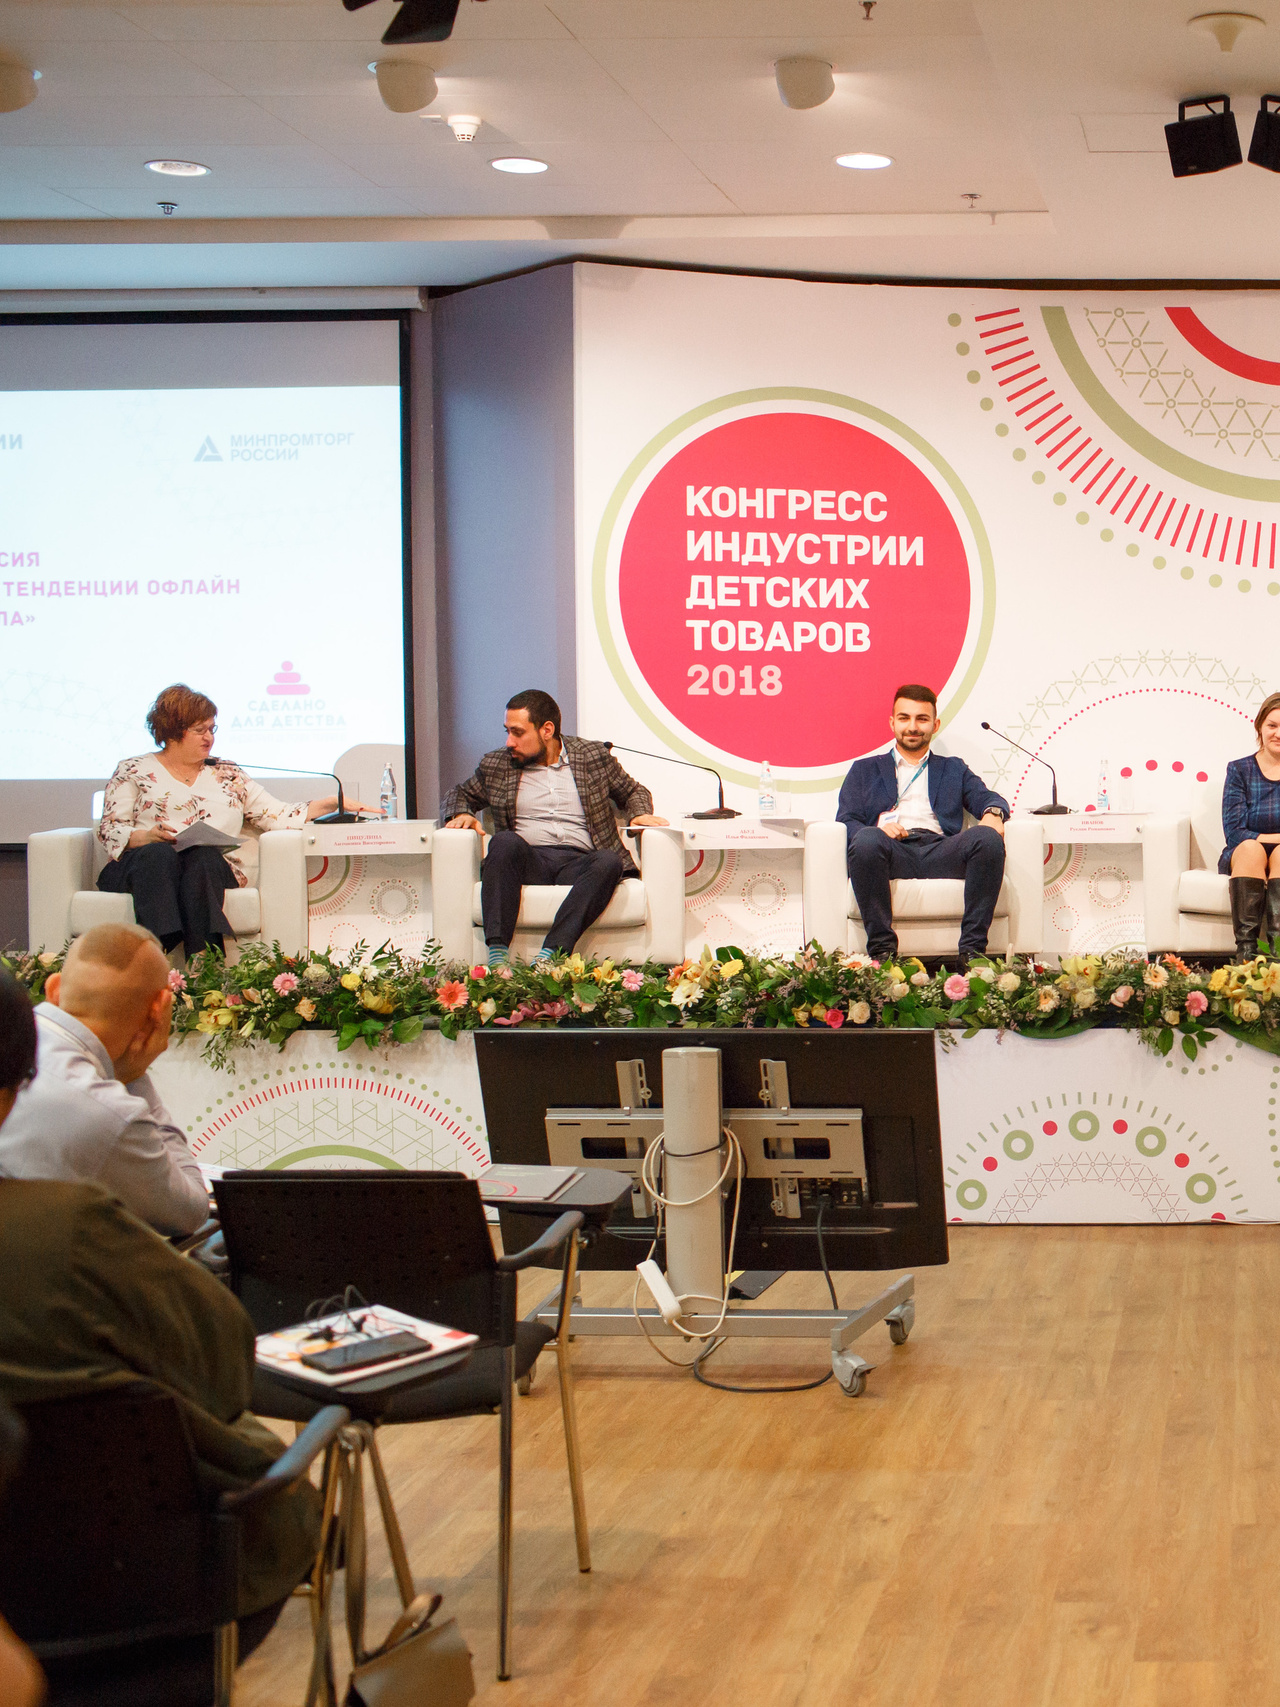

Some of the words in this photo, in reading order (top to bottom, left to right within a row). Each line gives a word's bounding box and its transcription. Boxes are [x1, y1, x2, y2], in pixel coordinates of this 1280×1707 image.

[230, 432, 354, 447] МИНПРОМТОРГ
[230, 448, 299, 462] РОССИИ
[686, 485, 887, 523] КОНГРЕСС
[686, 530, 924, 567] ИНДУСТРИИ
[3, 581, 138, 597] ТЕНДЕНЦИИ
[147, 575, 240, 595] ОФЛАЙН
[686, 575, 870, 610] ДЕТСКИХ
[686, 619, 871, 654] ТОВАРОВ
[686, 664, 783, 697] 2018
[248, 699, 326, 713] СДЕЛАНО
[231, 715, 265, 728] ДЛЯ
[271, 714, 346, 728] ДЕТСТВА
